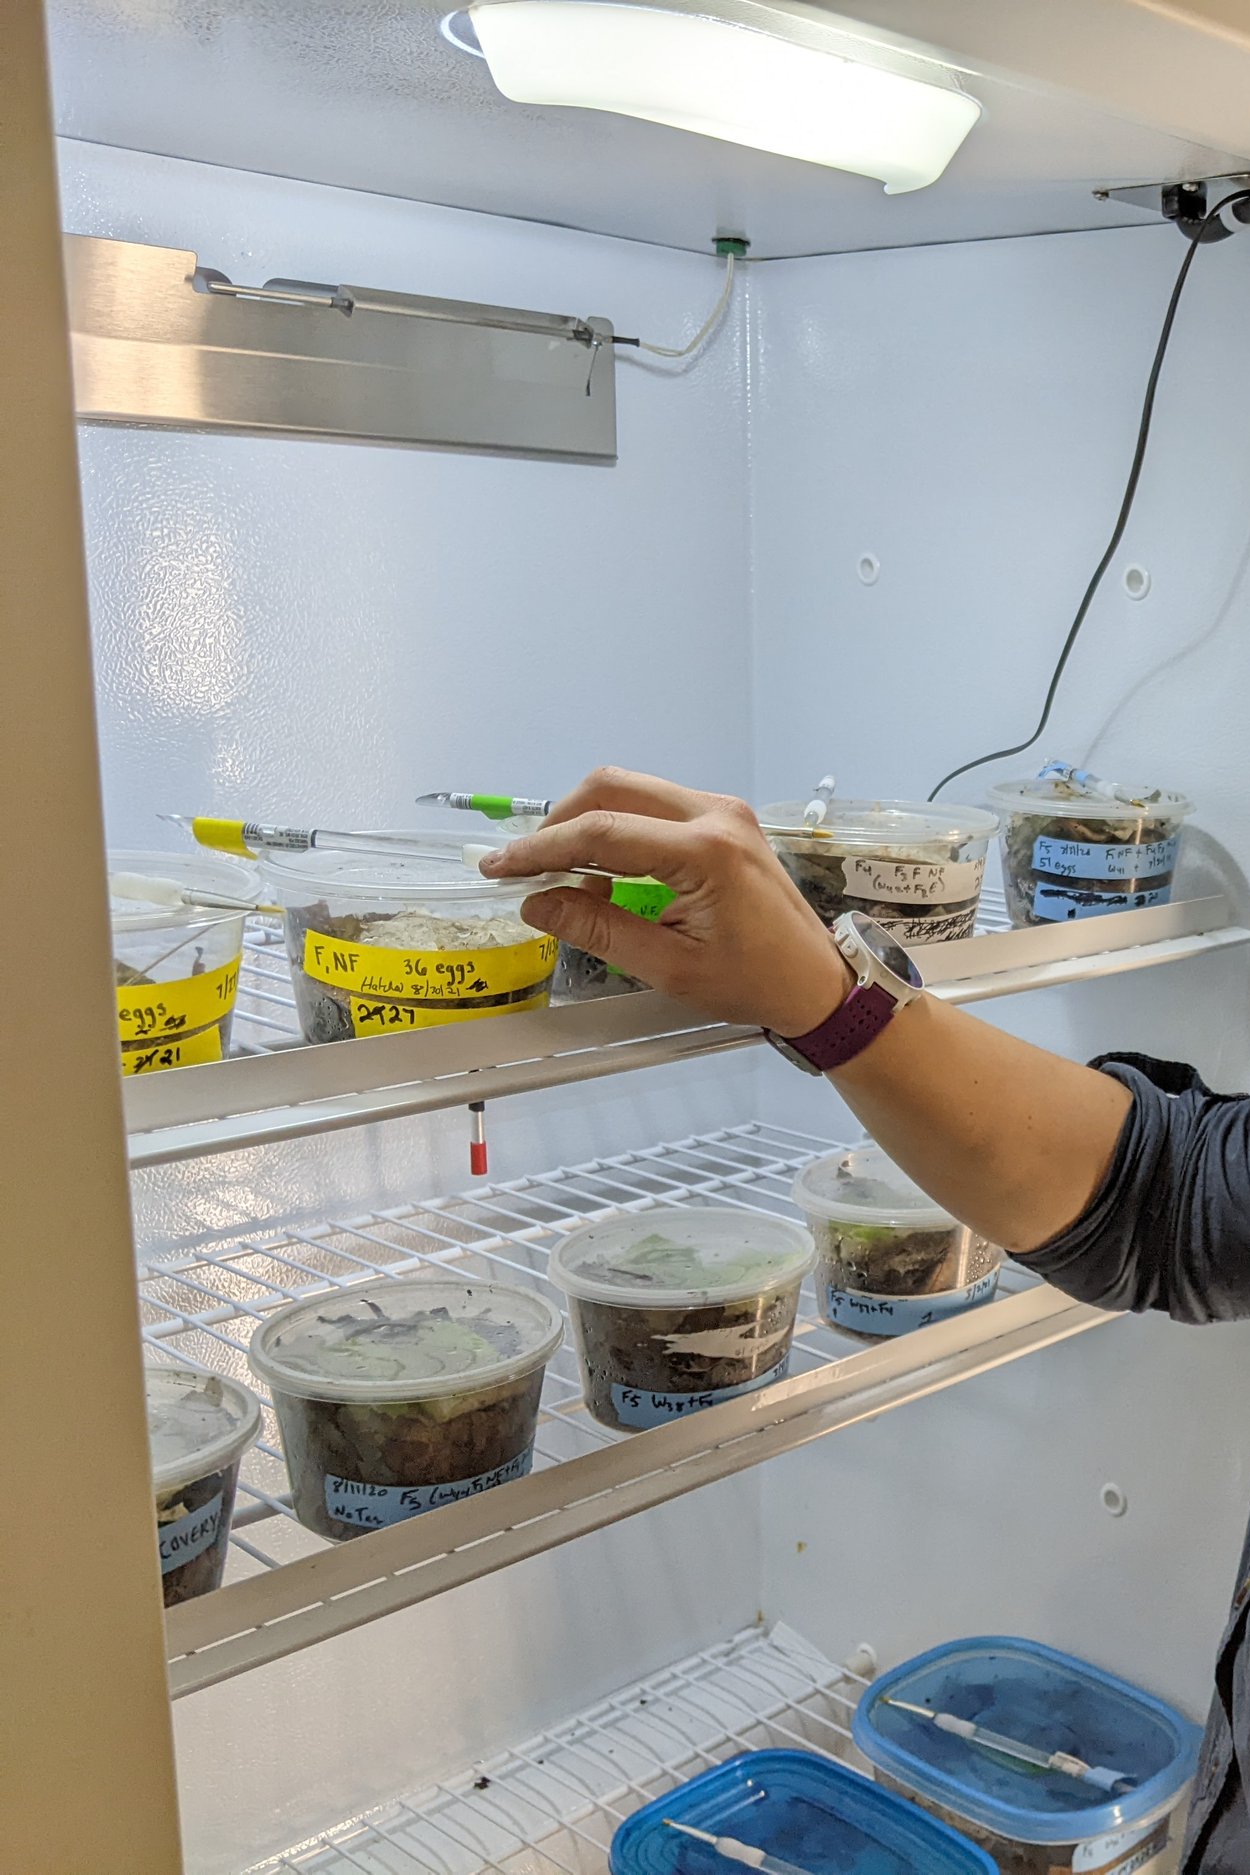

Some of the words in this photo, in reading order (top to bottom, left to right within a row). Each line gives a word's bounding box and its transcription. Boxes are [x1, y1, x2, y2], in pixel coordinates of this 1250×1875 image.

[403, 958, 428, 976] 36
[435, 960, 476, 987] eggs
[118, 1002, 167, 1029] eggs
